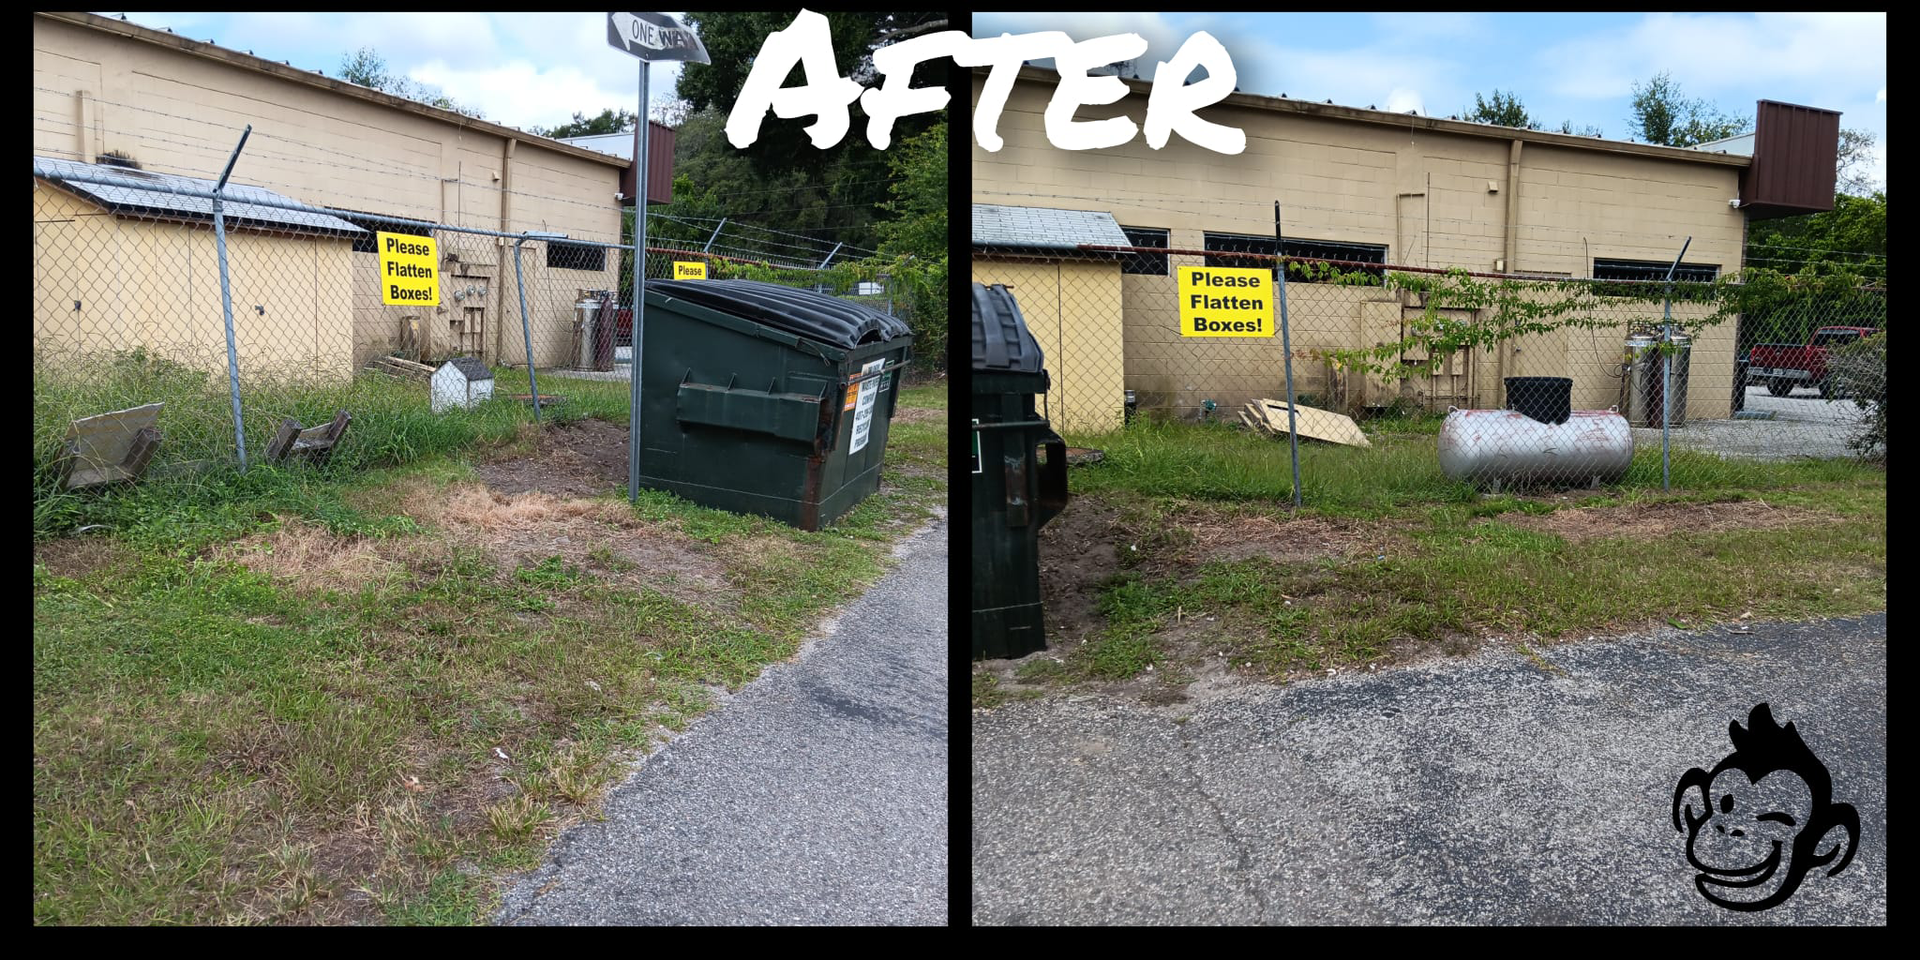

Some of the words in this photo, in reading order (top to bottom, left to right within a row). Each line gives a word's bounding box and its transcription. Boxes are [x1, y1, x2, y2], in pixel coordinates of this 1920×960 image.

[632, 19, 655, 45] ONE
[658, 29, 697, 49] WAY
[386, 238, 430, 256] Please
[387, 261, 432, 279] Flatten
[678, 265, 702, 276] Please
[1191, 272, 1260, 288] Please
[390, 285, 432, 300] Boxes!
[1190, 294, 1263, 310] Flatten
[1193, 317, 1262, 332] Boxes!
